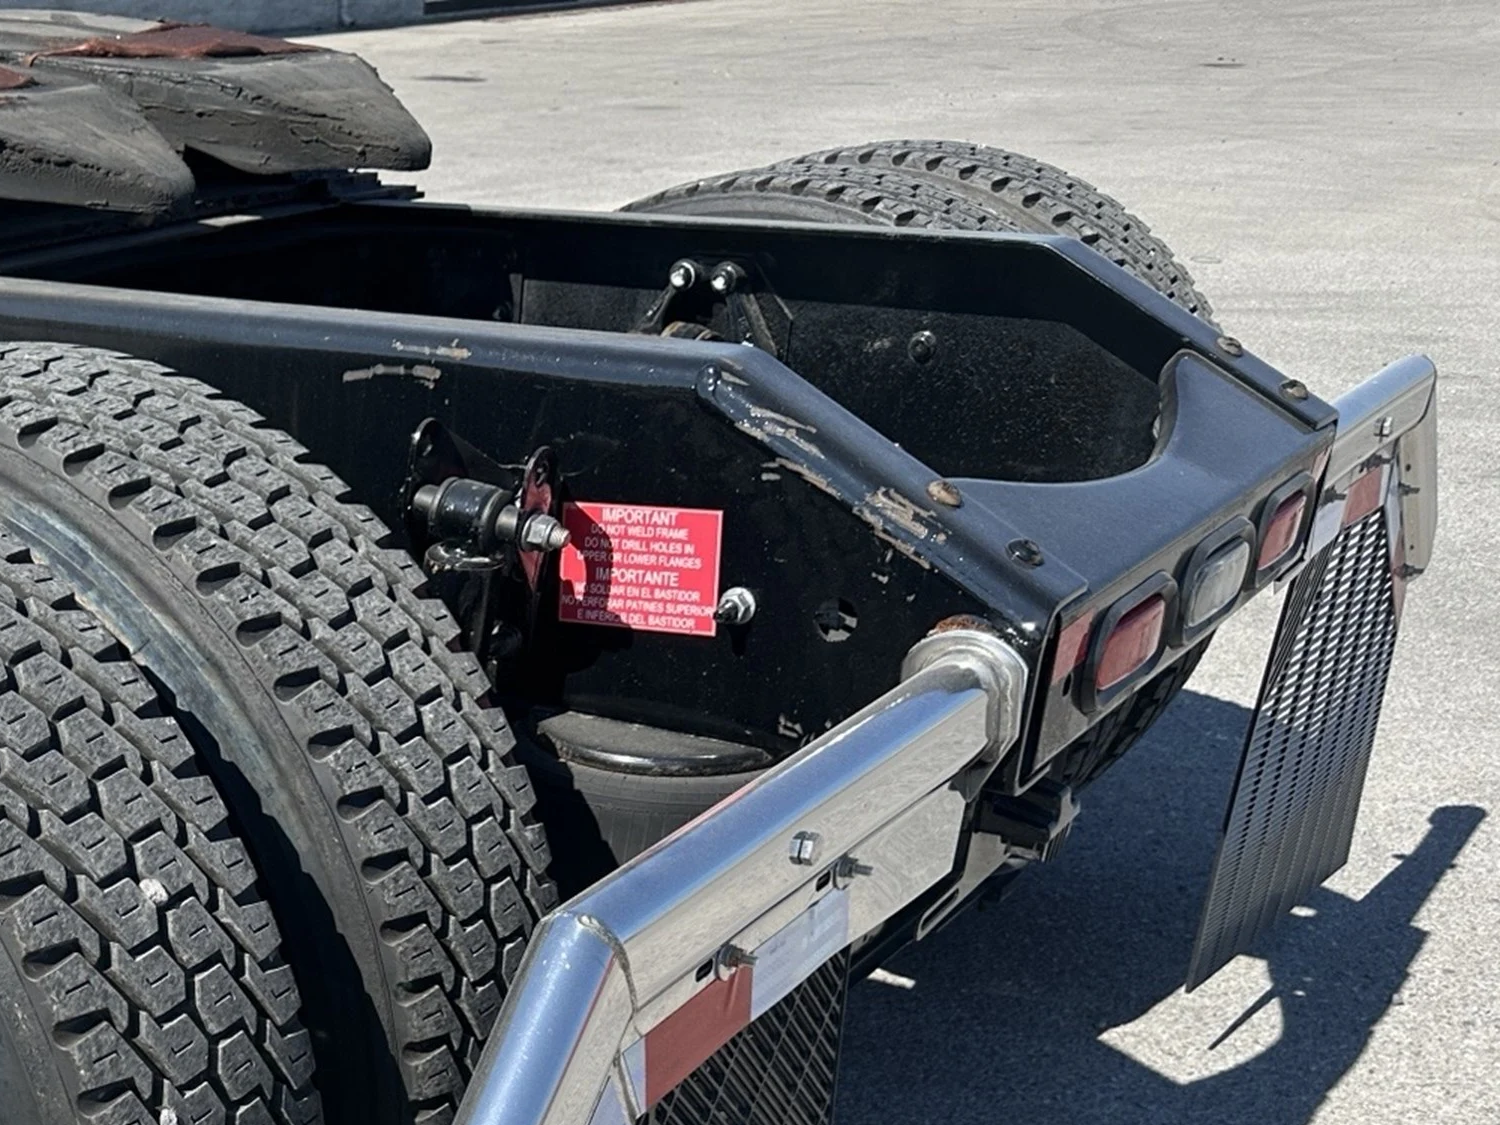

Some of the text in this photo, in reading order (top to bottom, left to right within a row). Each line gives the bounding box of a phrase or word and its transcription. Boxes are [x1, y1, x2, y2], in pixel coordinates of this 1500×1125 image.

[603, 508, 678, 526] IMPORTANT
[591, 524, 689, 541] DO NOT WELD FRAME
[585, 537, 696, 556] DO NOT DRILL HOLES IN
[577, 549, 702, 570] UPPER OR LOWER FLANGES
[596, 567, 680, 587] IMPORTANTE
[626, 585, 640, 598] EN
[641, 587, 653, 599] EL
[654, 588, 701, 603] BASTIDOR
[562, 594, 575, 606] NO
[625, 599, 665, 614] PATINES
[628, 612, 647, 626] DEL
[648, 614, 696, 629] BASTIDOR
